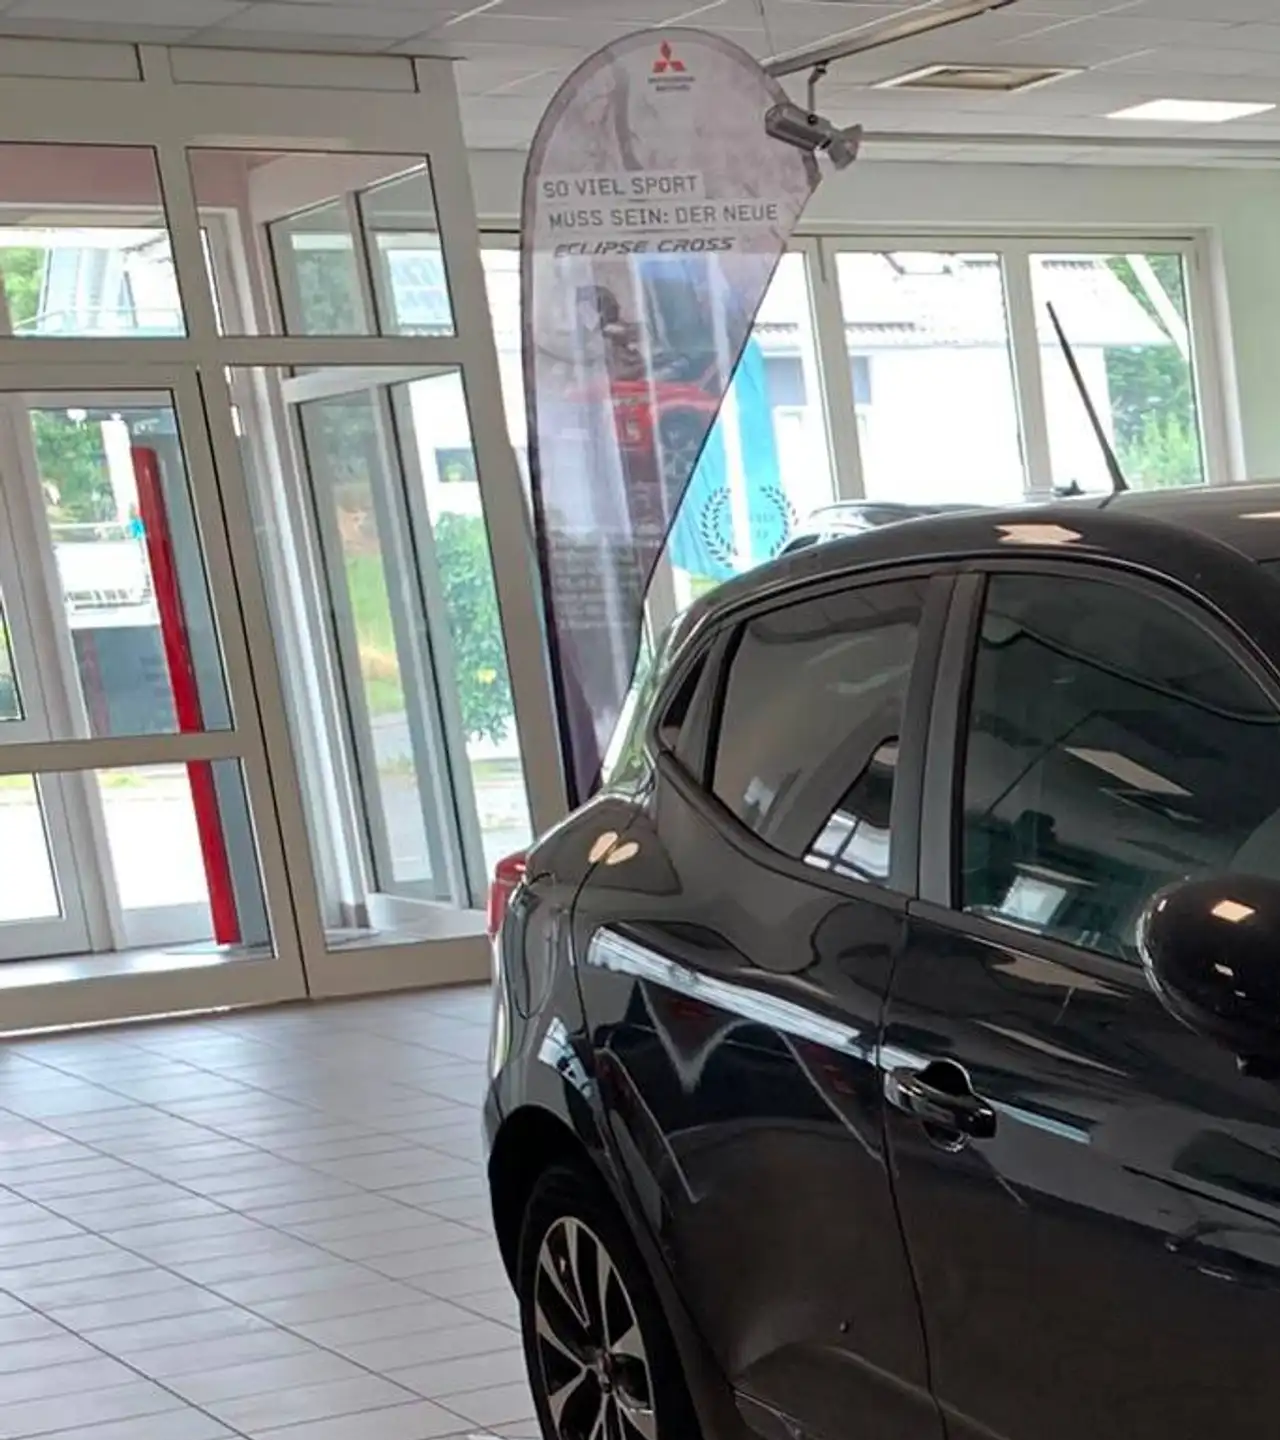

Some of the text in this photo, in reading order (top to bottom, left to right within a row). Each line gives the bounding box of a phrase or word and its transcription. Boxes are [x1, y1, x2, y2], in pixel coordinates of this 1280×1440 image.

[542, 175, 698, 199] SO VIEL SPORT
[548, 204, 778, 229] MUSS SEIN: DER NEUE
[553, 236, 737, 258] ECLIPSE CROSS
